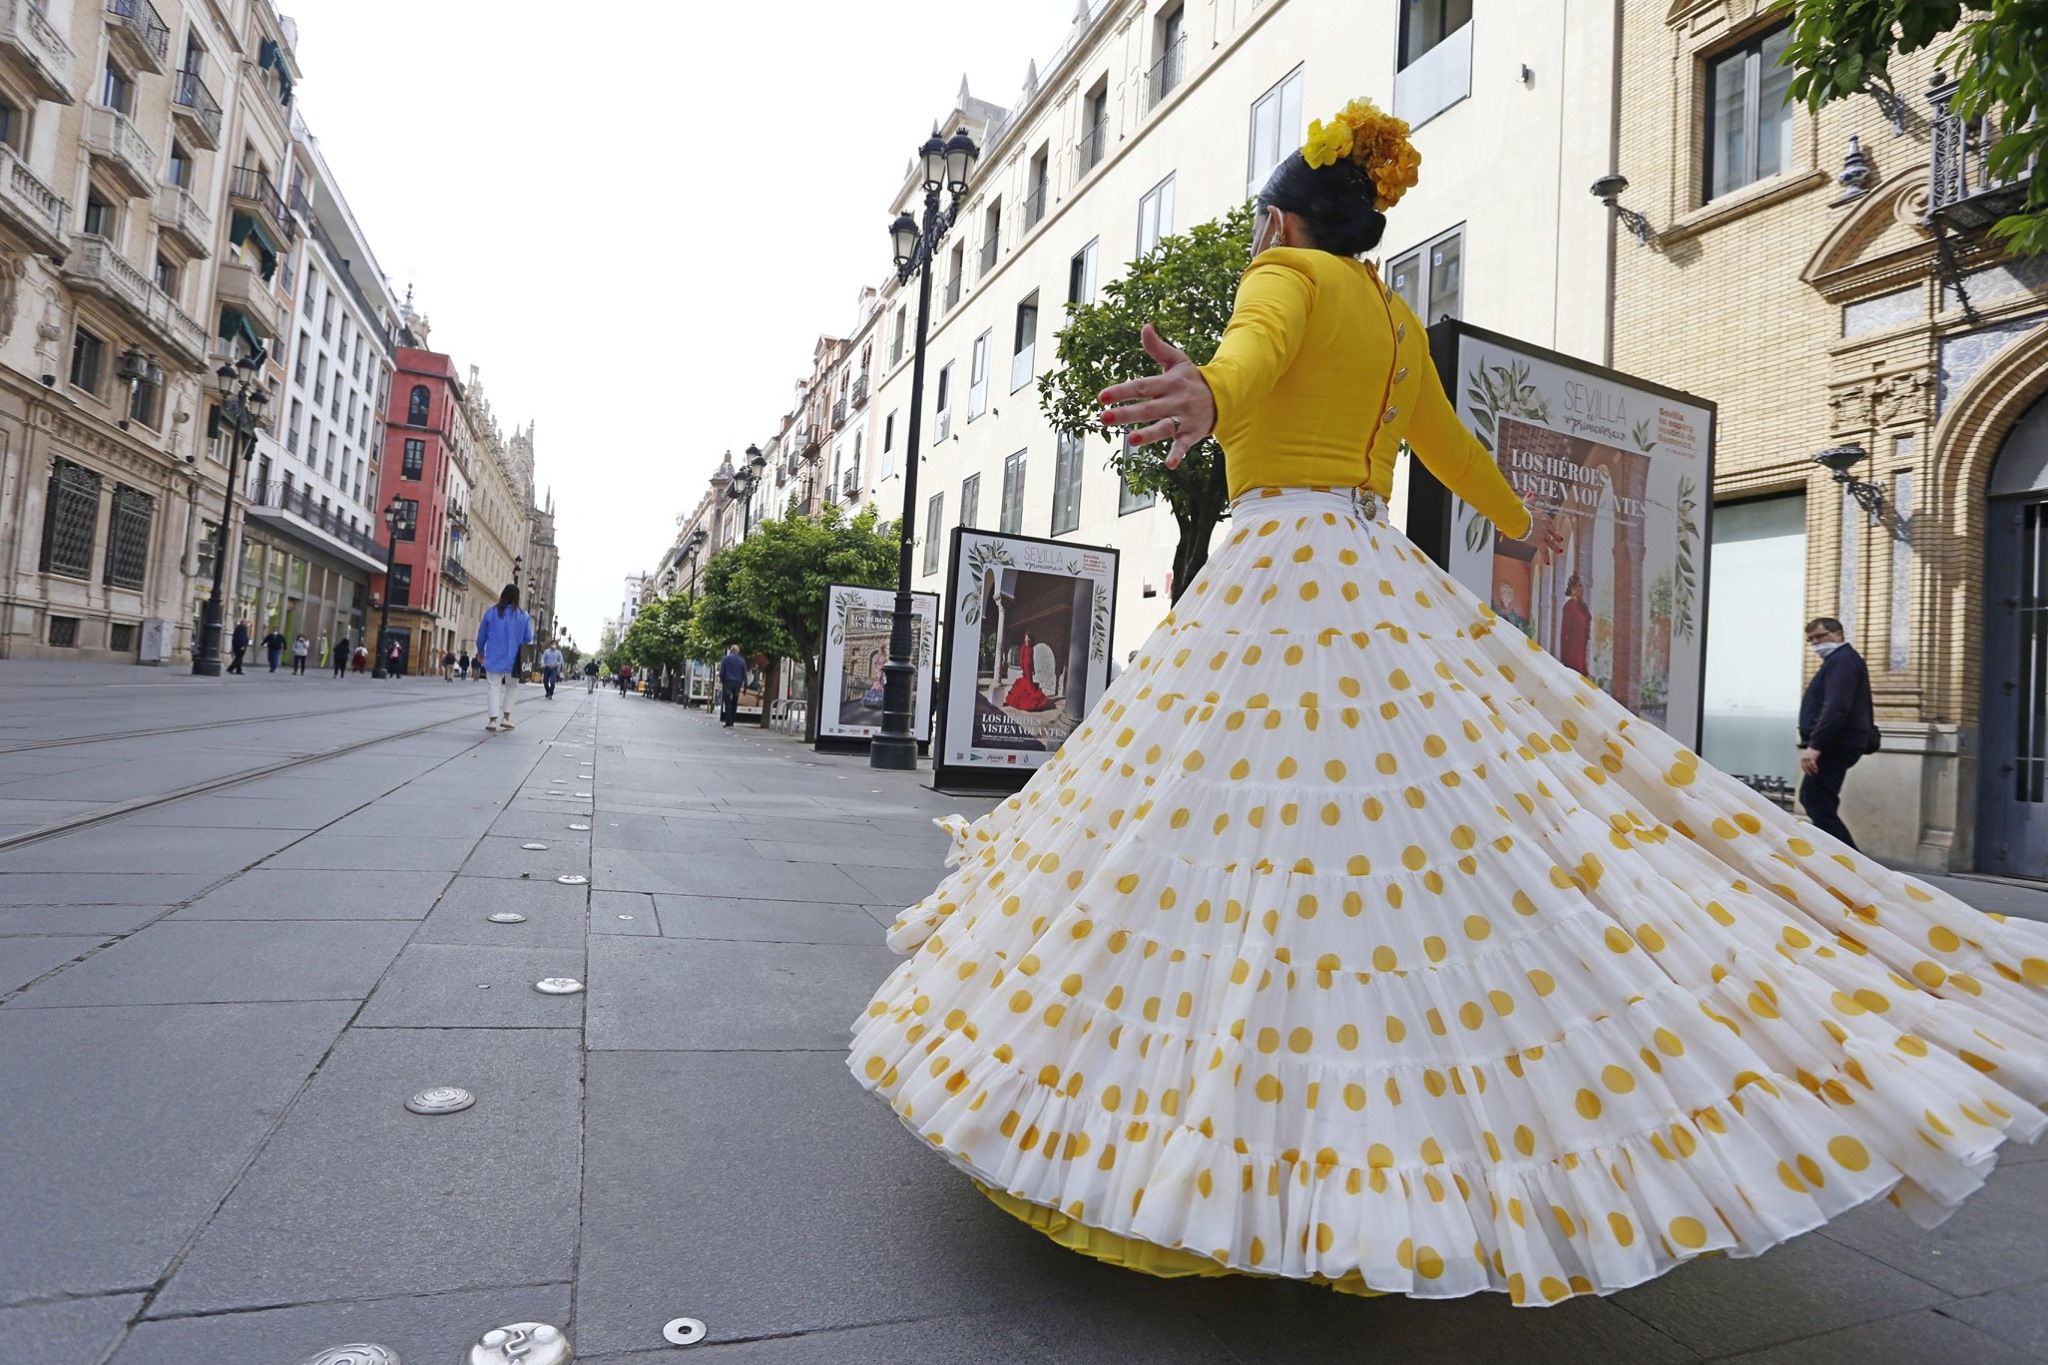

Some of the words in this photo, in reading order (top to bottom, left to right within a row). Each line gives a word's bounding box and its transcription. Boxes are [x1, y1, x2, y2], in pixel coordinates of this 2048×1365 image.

[1564, 380, 1626, 426] SEVILLA
[1512, 448, 1543, 473] LOS
[1547, 456, 1609, 488] HÉROES
[1512, 470, 1568, 501] VISTEN
[1572, 484, 1648, 518] VOLNTES
[1024, 546, 1063, 565] SEVILLA
[982, 713, 1001, 724] LOS
[982, 723, 1016, 735] VISTEN
